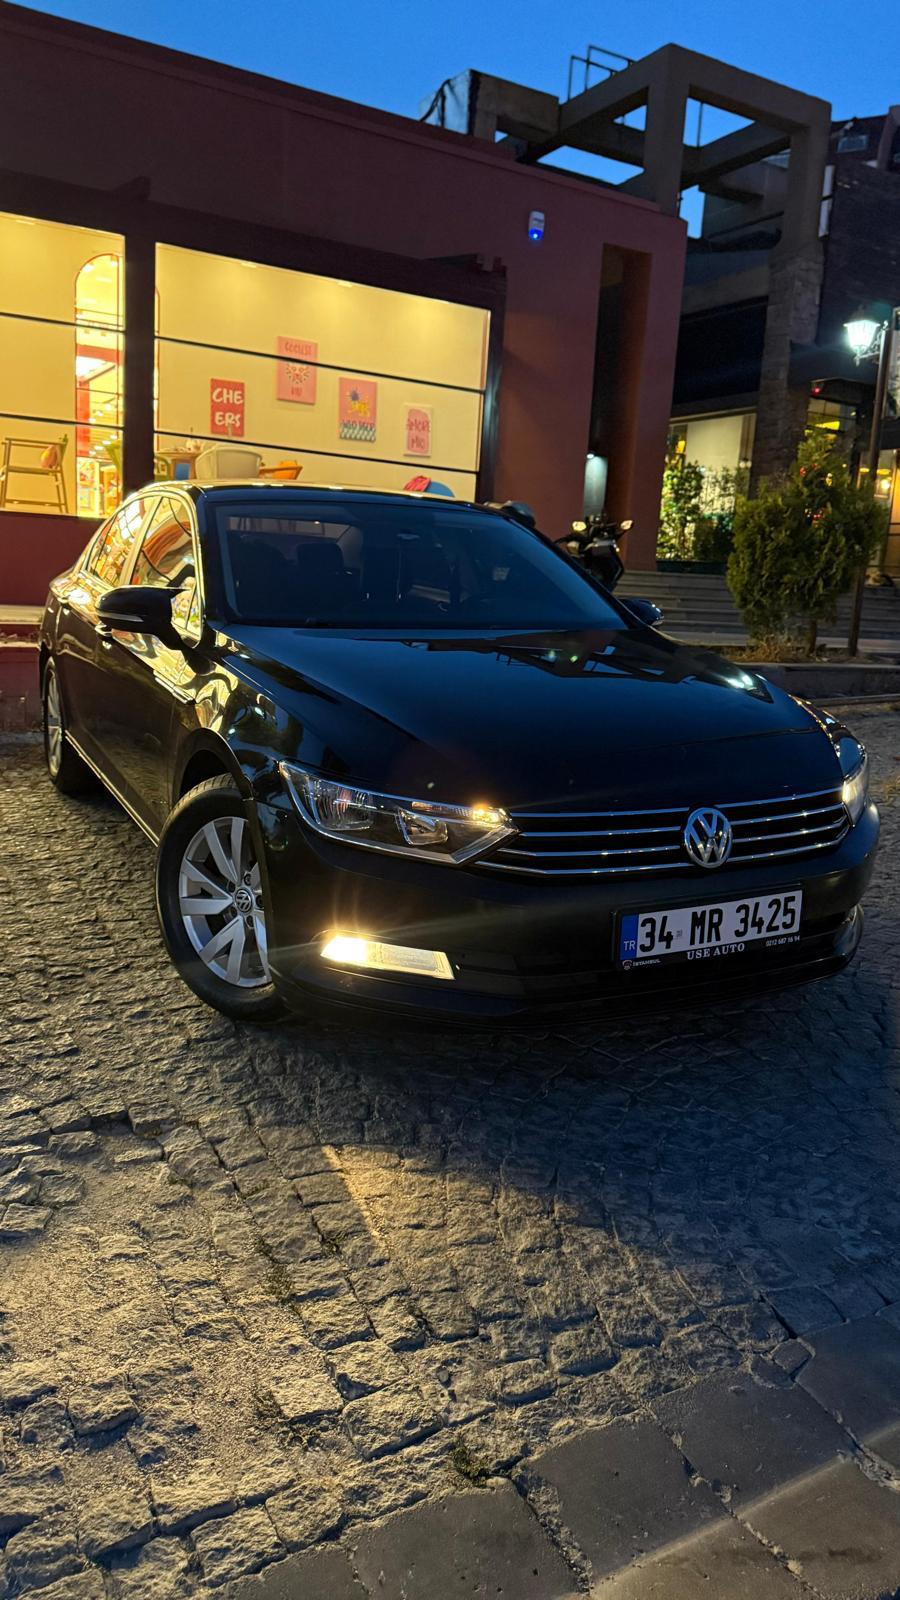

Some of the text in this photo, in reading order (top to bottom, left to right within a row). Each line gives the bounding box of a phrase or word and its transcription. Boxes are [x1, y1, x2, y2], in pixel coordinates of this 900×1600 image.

[212, 388, 243, 405] CHE
[214, 411, 241, 428] ERS
[623, 896, 796, 952] TR 34 MR 3425
[687, 943, 745, 960] USE AUTO
